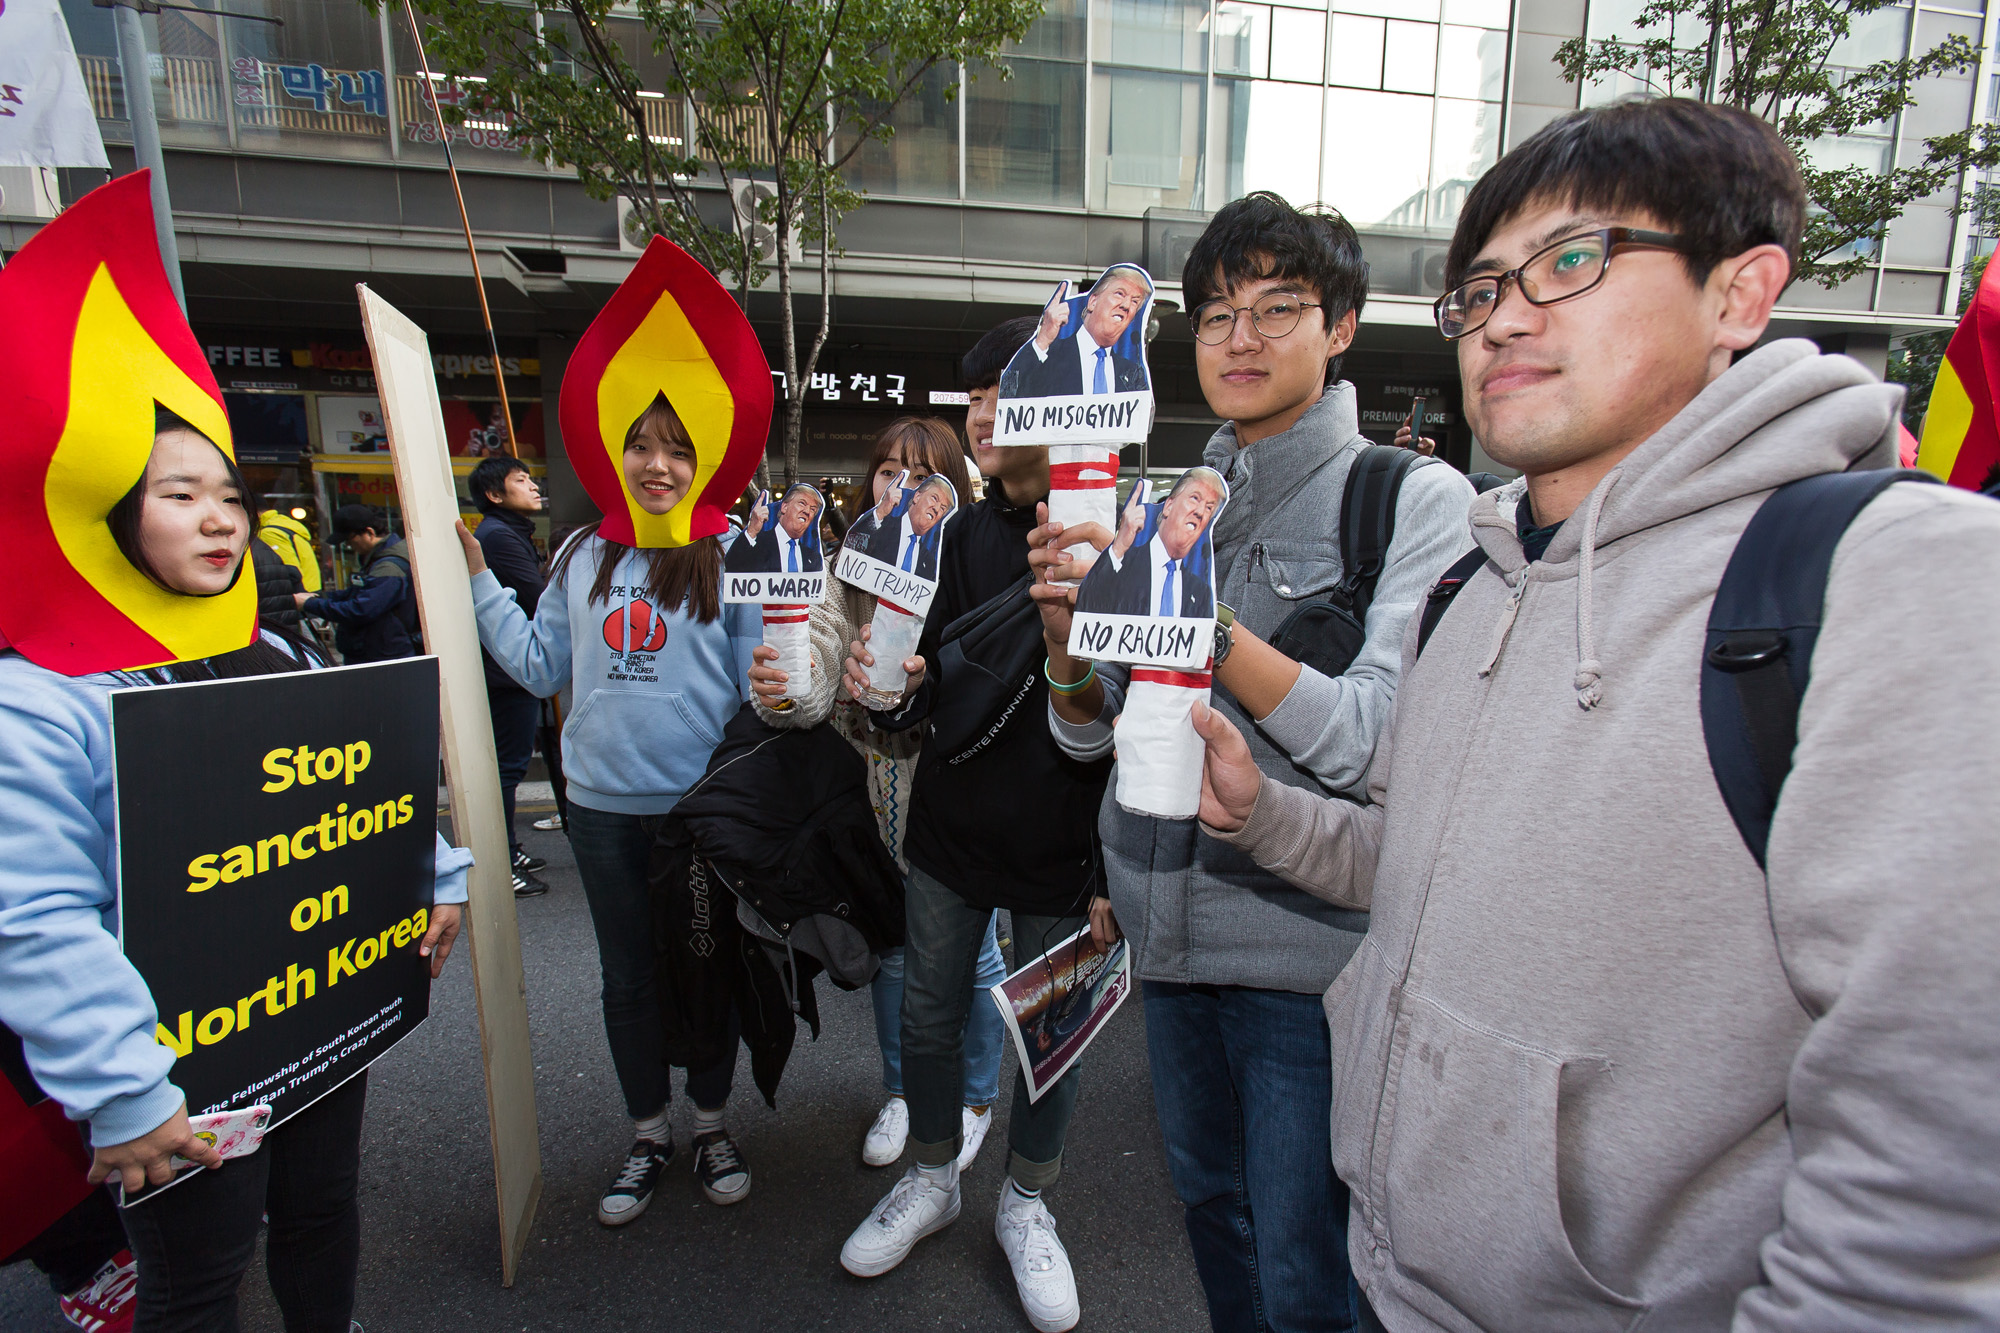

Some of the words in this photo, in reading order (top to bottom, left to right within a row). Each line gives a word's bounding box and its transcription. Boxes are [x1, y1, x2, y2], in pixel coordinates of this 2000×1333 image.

[231, 57, 264, 106] 원조
[278, 64, 388, 117] 막내
[205, 345, 282, 368] FFEE
[309, 342, 373, 369] Kod
[431, 354, 521, 379] xpress
[933, 393, 969, 404] 2075-59
[1004, 405, 1035, 435] NO
[1042, 398, 1140, 430] MISOGYNY
[1421, 412, 1446, 424] TORE
[731, 578, 761, 598] NO
[768, 578, 822, 599] WAR!!
[841, 555, 867, 580] NO
[874, 567, 931, 605] TRUMP
[1079, 621, 1113, 652] NO
[1118, 624, 1196, 658] RACISM
[612, 665, 632, 673] NOTH
[988, 673, 1035, 737] RUNNING
[261, 740, 371, 793] Stop
[186, 794, 414, 893] sanctions
[290, 885, 349, 932] on
[154, 963, 316, 1059] North
[328, 908, 428, 988] Korea
[202, 1099, 229, 1115] The
[232, 1060, 300, 1104] Fellowship
[301, 1051, 315, 1065] of
[315, 1034, 346, 1057] South
[347, 1014, 379, 1038] Korean
[380, 996, 403, 1016] Youth
[253, 1086, 286, 1107] (Ban
[288, 1056, 339, 1089] Trump's
[340, 1033, 370, 1058] Crazy
[371, 1010, 402, 1039] action)
